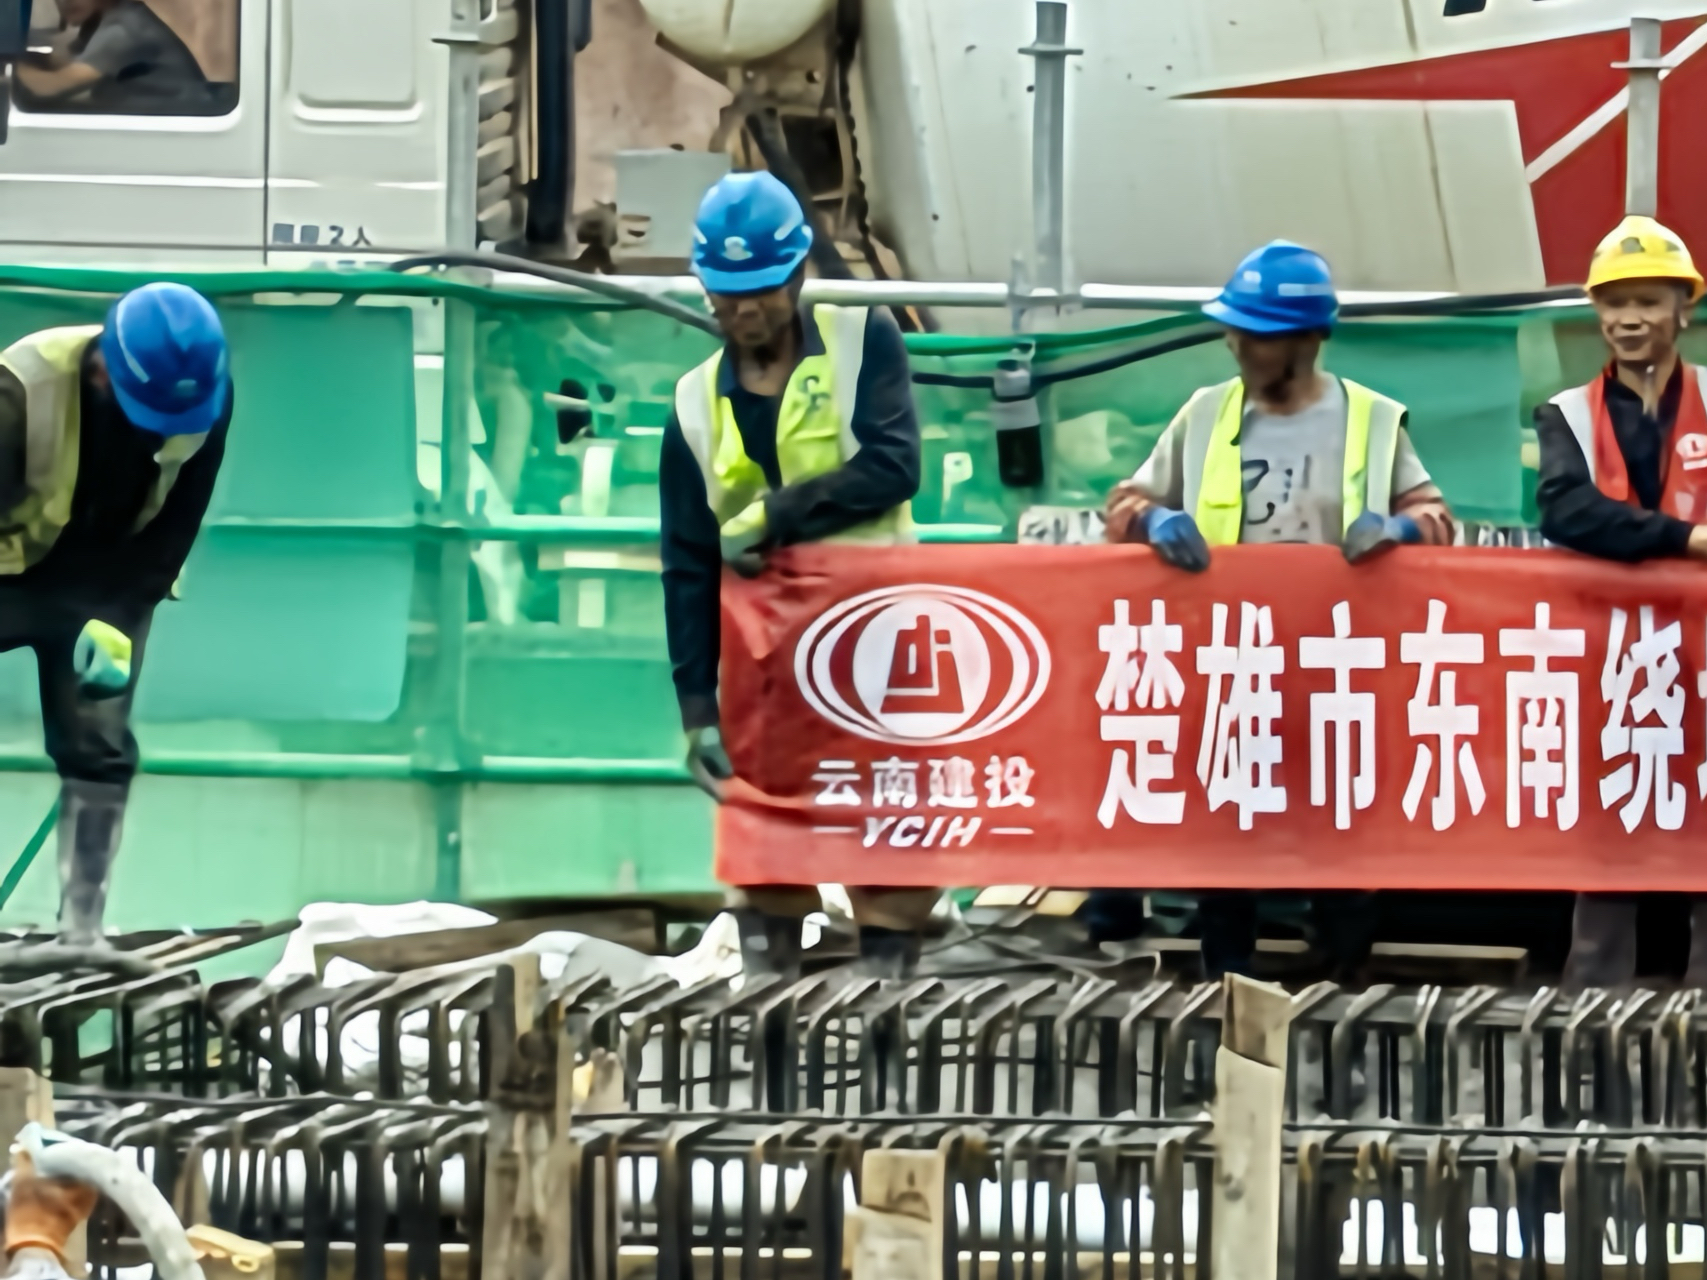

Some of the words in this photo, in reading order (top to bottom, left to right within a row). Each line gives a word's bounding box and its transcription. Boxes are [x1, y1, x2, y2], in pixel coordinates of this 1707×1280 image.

[811, 755, 1036, 808] 云南建投
[862, 815, 983, 848] YCIH
